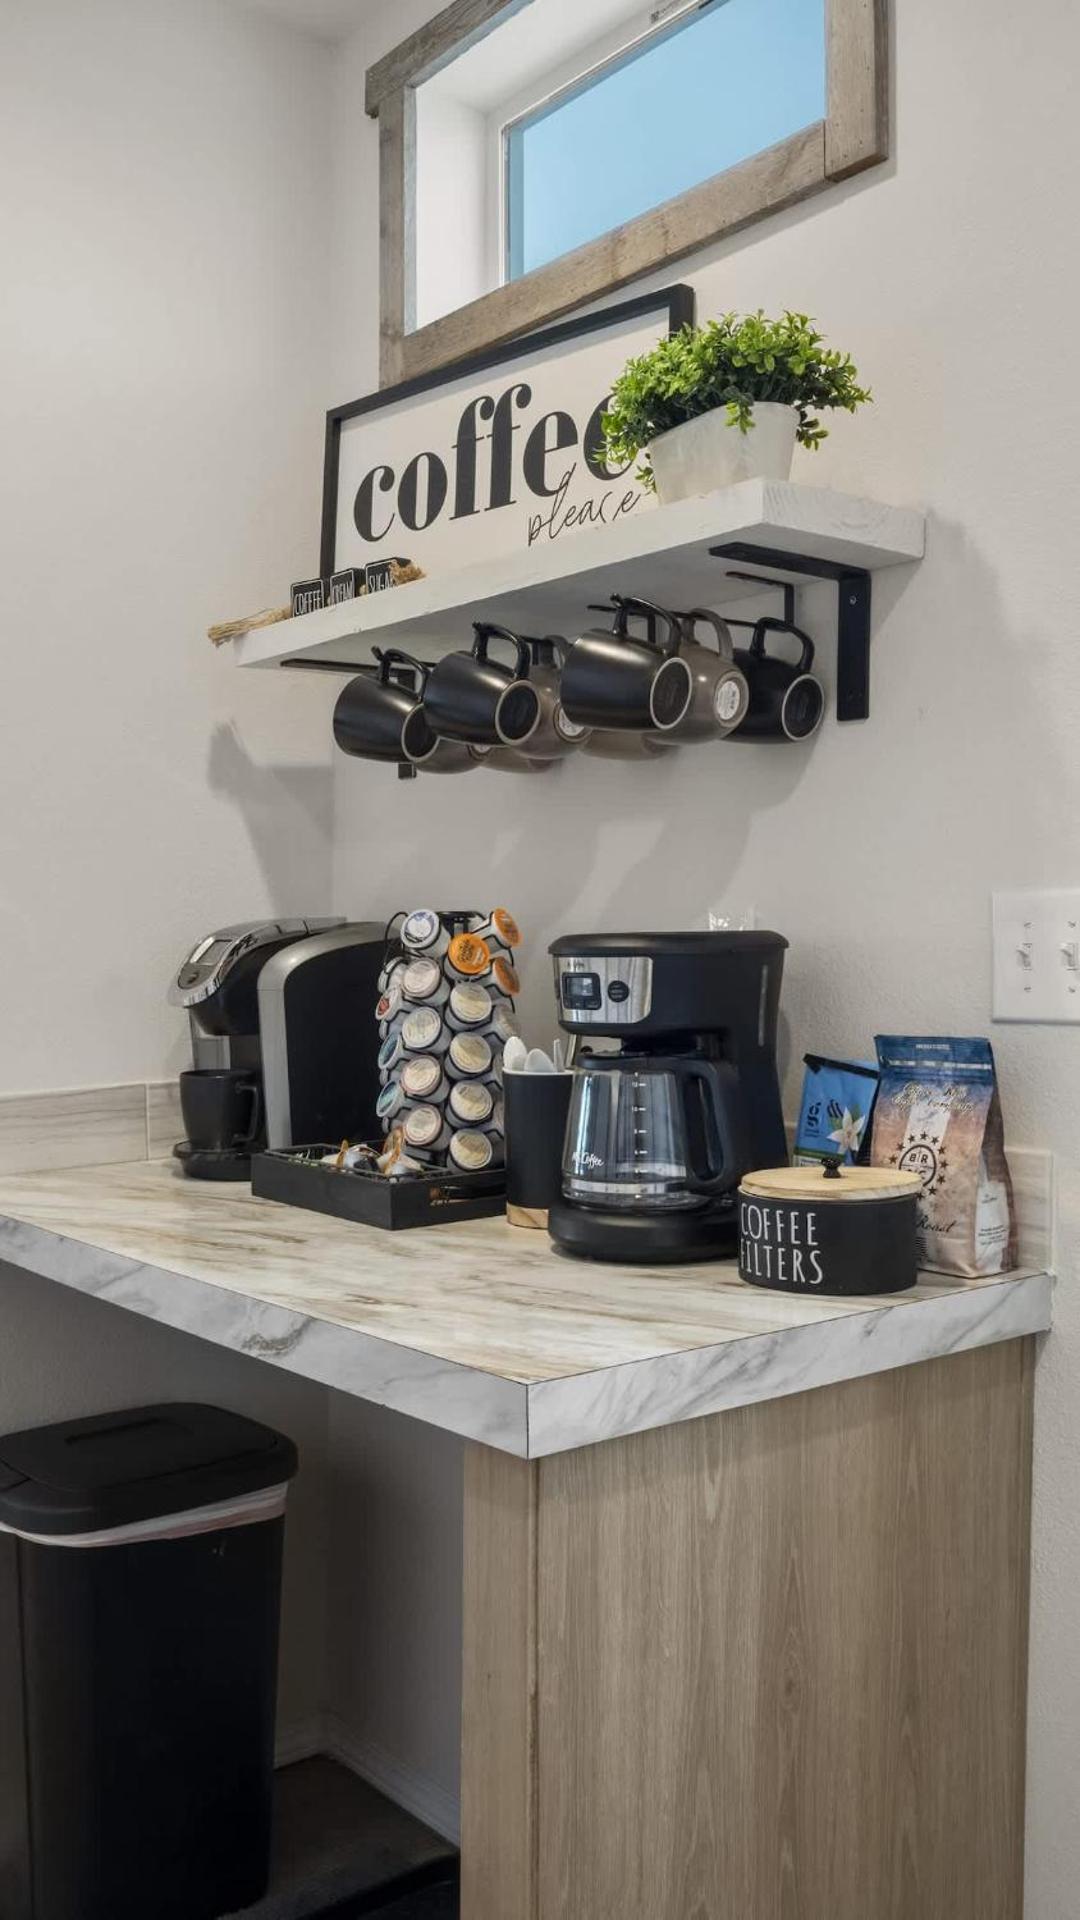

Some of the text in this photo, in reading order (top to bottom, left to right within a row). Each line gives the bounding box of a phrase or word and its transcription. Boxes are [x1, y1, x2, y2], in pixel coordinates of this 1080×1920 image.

[528, 462, 641, 547] please
[295, 589, 321, 615] COFFEE
[741, 1202, 818, 1246] COFFEE
[740, 1238, 823, 1284] FILTERS
